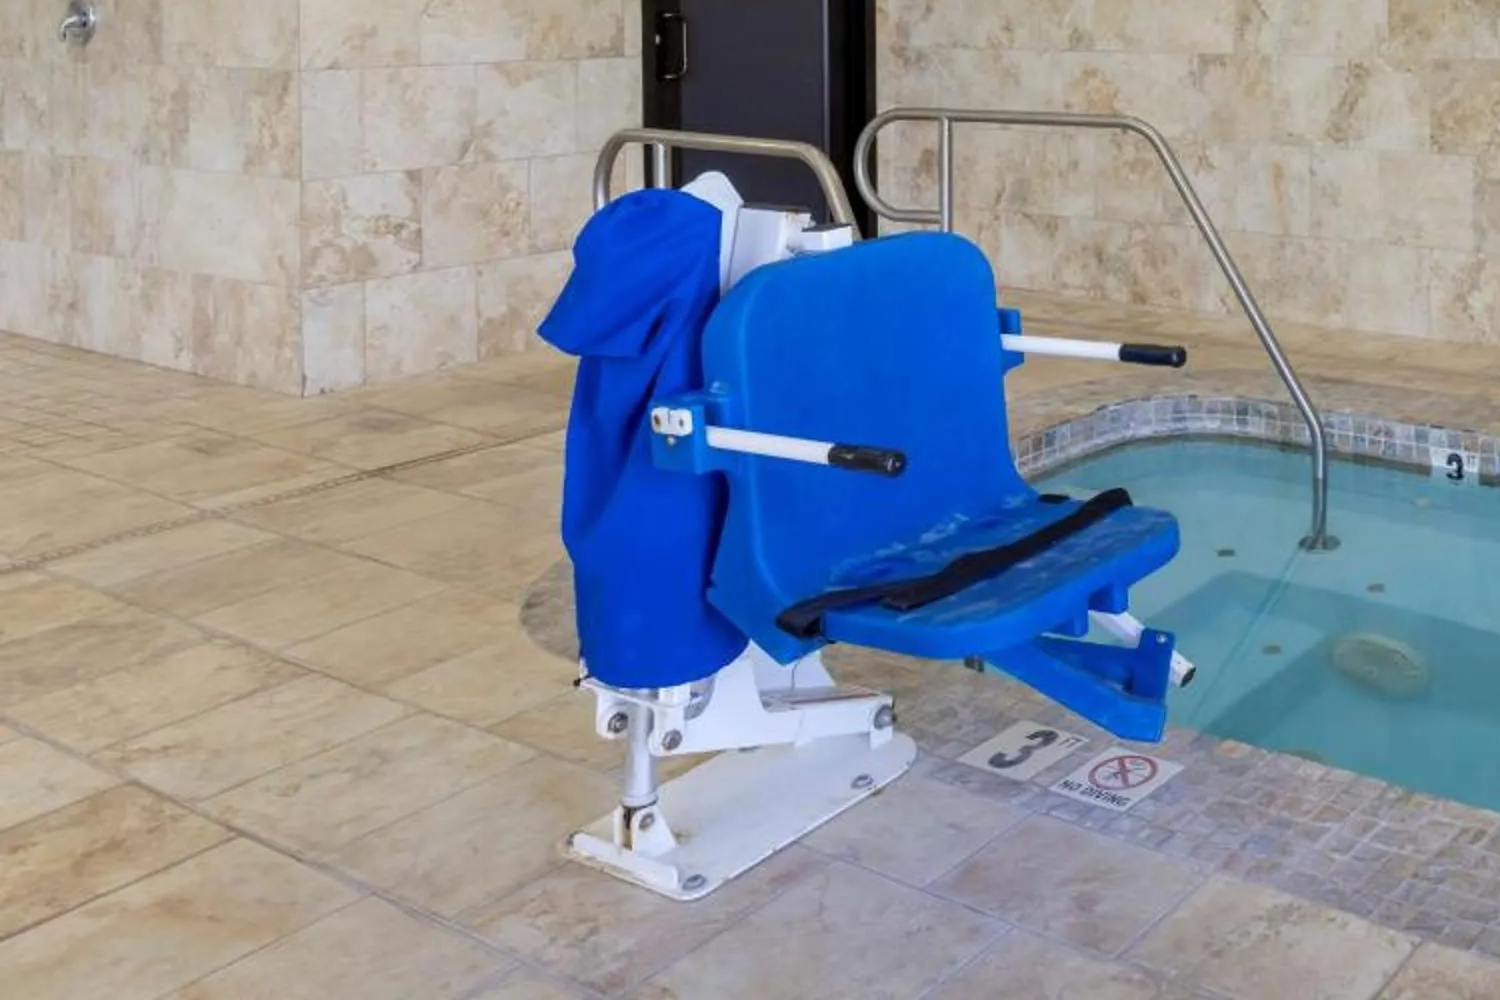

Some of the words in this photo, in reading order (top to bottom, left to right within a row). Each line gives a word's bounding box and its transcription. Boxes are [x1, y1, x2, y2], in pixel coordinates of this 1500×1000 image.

[1446, 452, 1464, 480] 3
[988, 729, 1060, 770] 3
[1058, 779, 1083, 796] NO
[1079, 785, 1132, 808] DIVING
